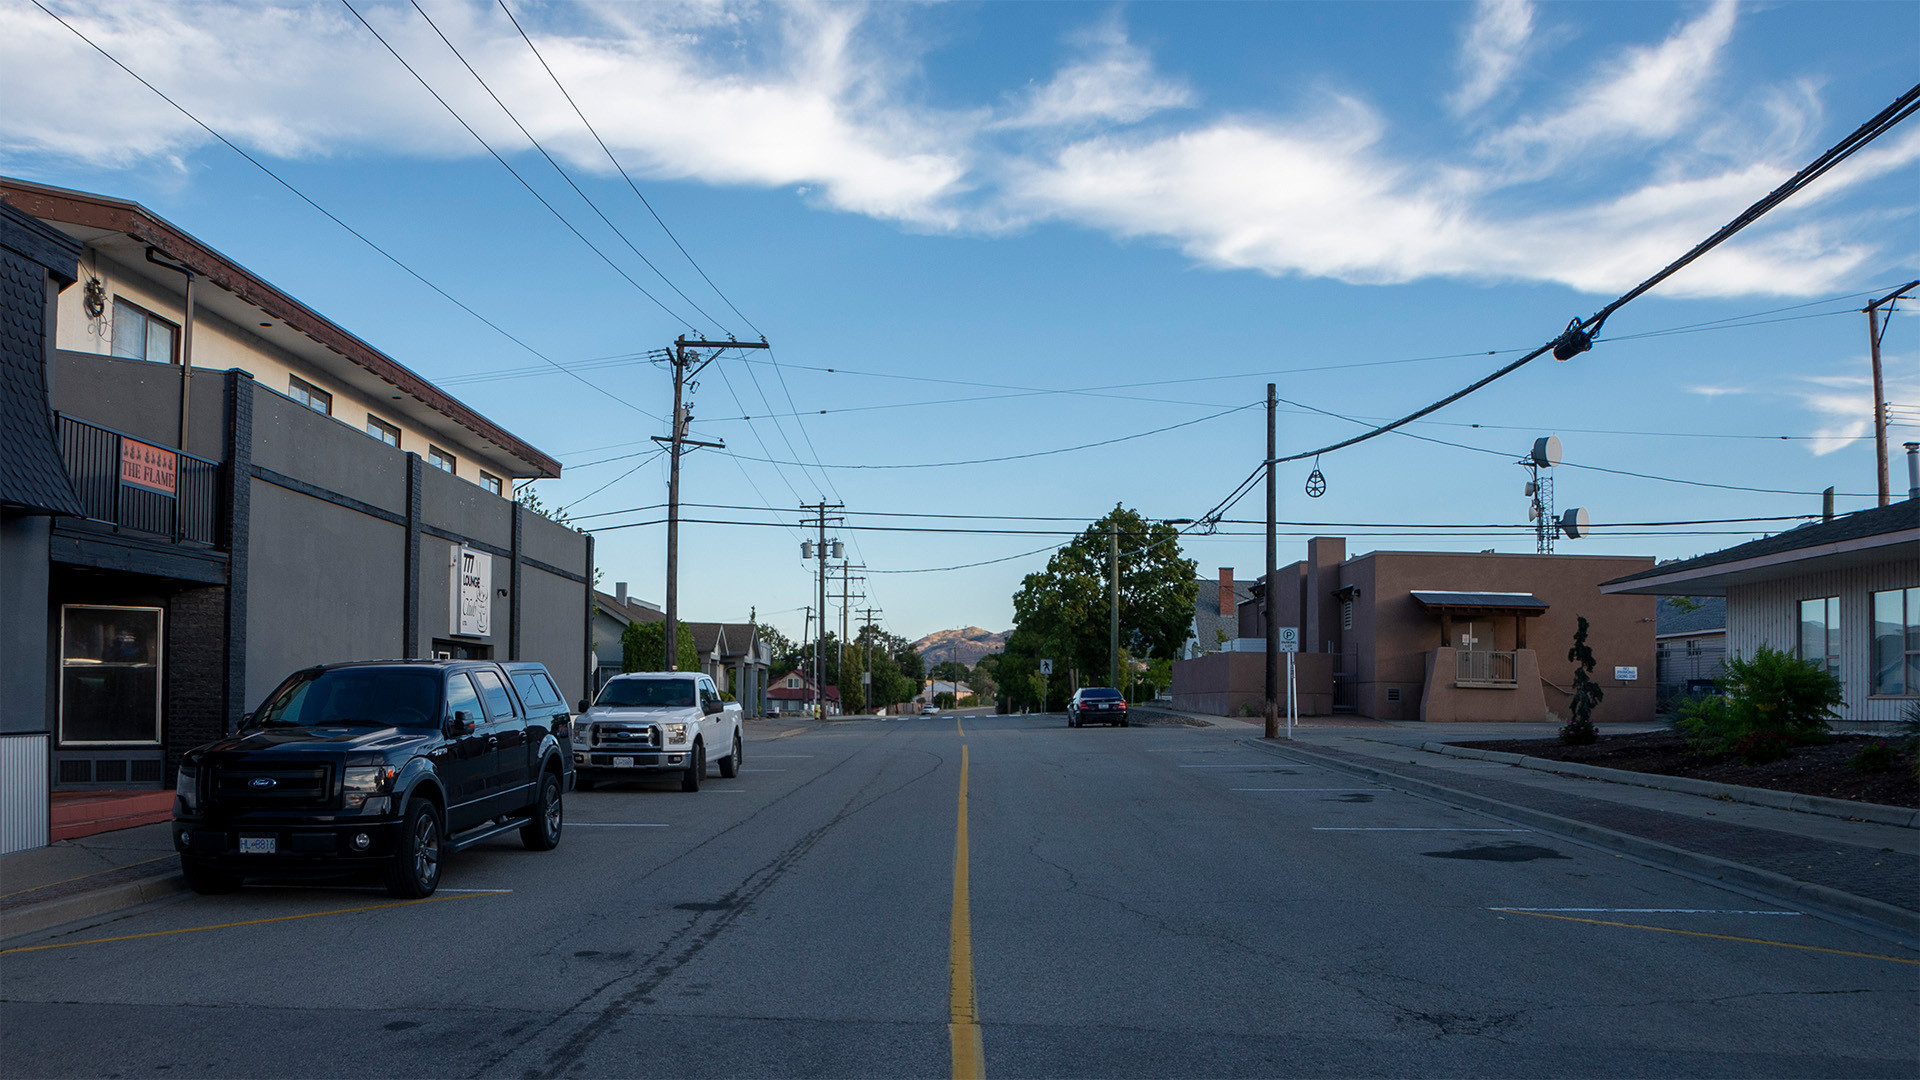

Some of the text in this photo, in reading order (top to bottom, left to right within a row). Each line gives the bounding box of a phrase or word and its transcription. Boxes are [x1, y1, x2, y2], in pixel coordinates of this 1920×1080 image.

[122, 461, 174, 488] THE FLAME
[463, 574, 480, 589] LOUNGE
